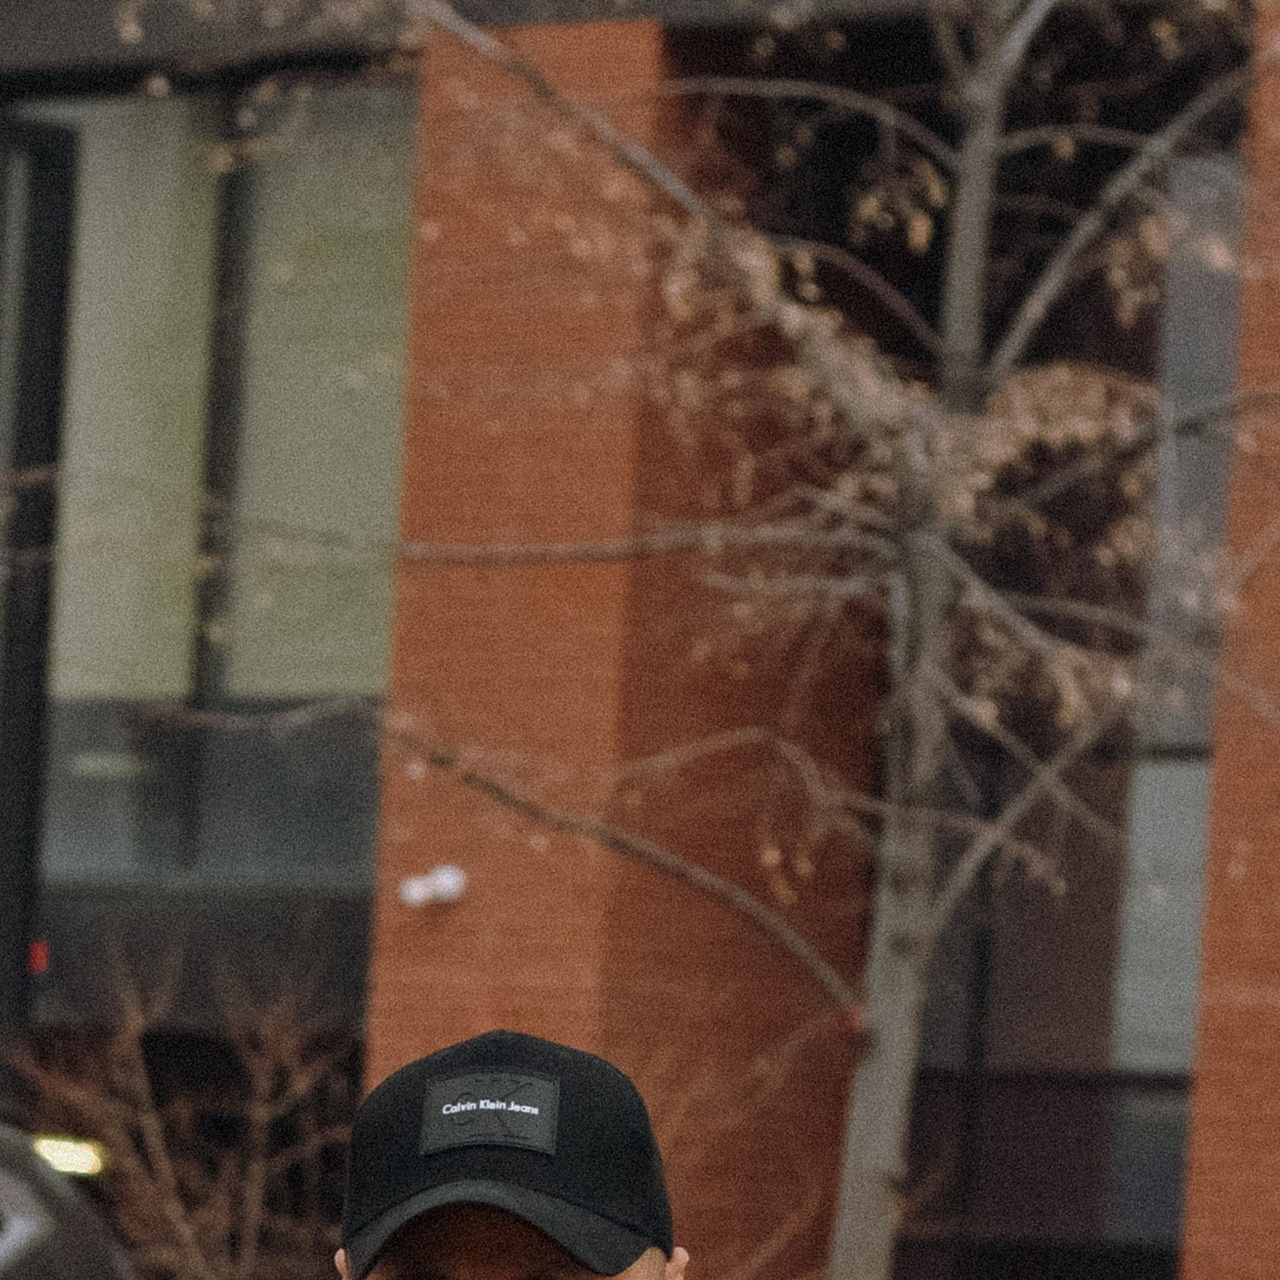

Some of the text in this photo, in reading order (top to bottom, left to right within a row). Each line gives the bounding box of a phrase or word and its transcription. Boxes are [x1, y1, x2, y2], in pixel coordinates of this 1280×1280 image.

[442, 1099, 539, 1115] Calvin Klein Jeans
